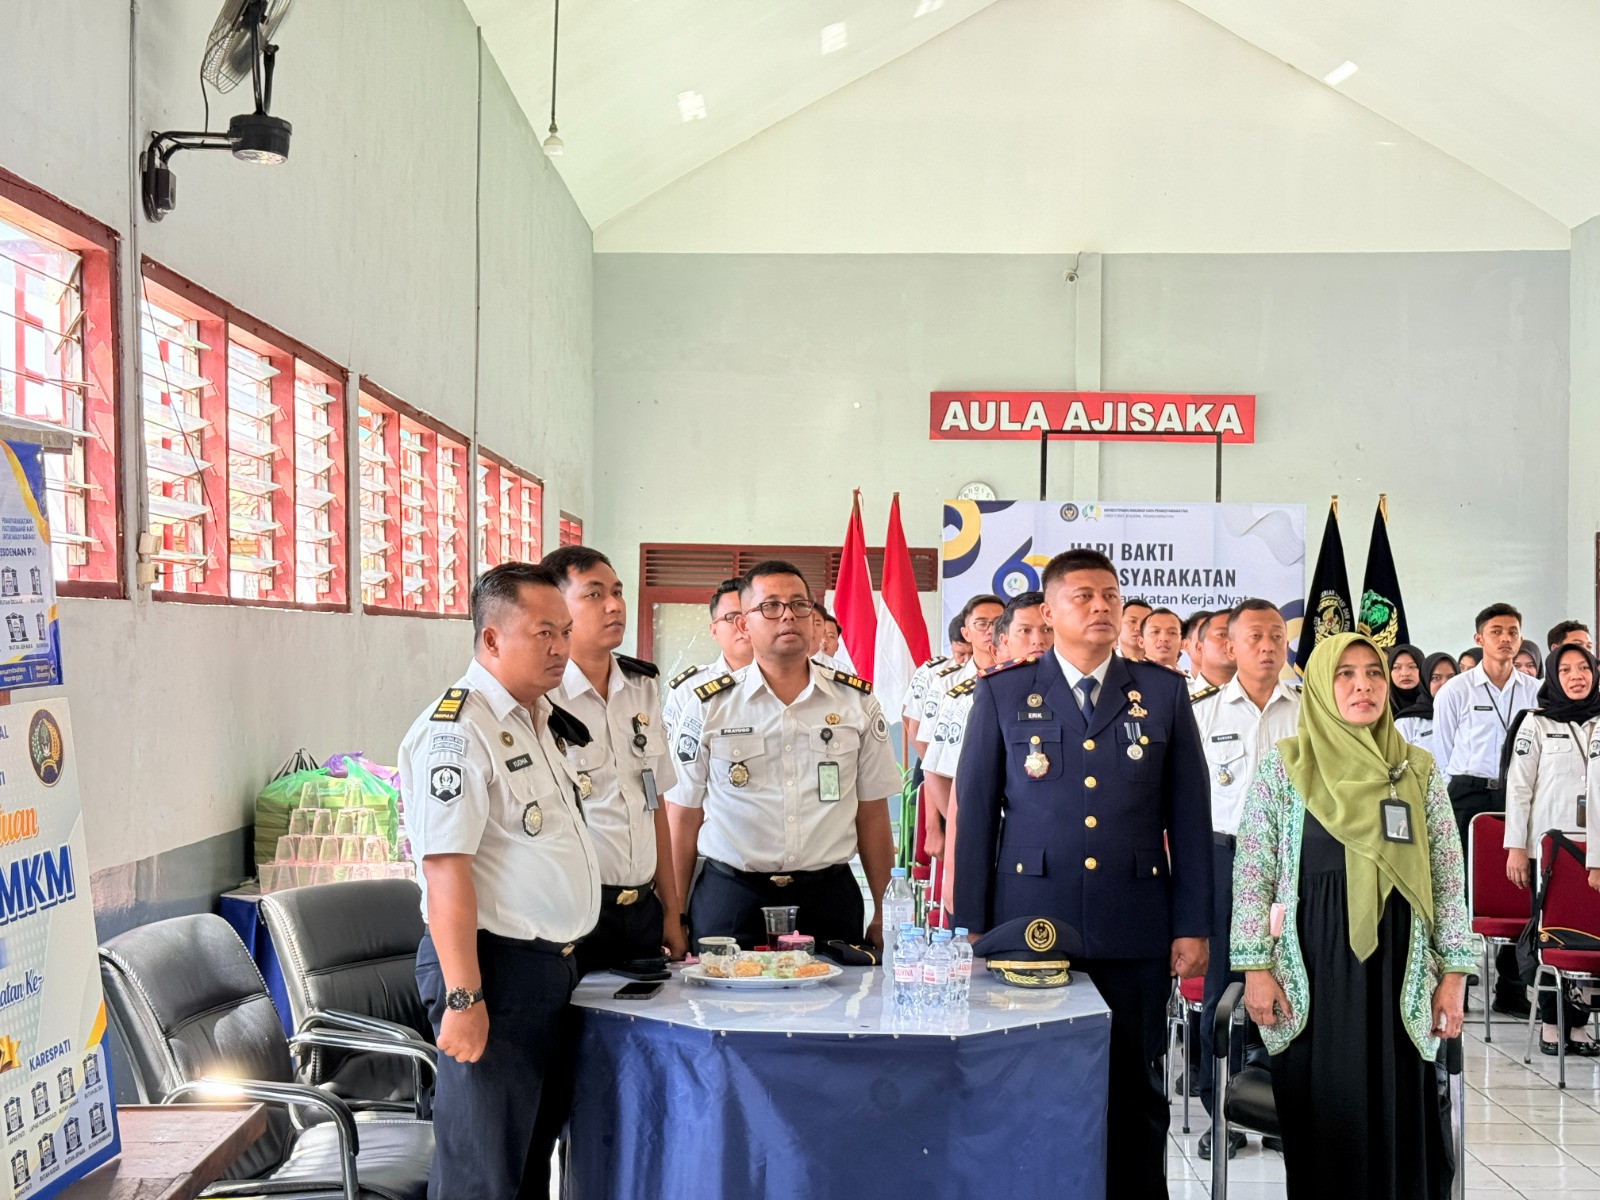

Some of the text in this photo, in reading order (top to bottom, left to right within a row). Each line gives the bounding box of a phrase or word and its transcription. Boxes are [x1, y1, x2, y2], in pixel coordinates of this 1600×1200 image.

[941, 400, 1244, 434] AULA AJISAKA
[1121, 543, 1174, 562] BAKTI
[1120, 568, 1236, 588] SYARAKATAN
[1181, 594, 1214, 608] Kerja
[512, 756, 529, 768] YUDHA
[0, 806, 38, 842] uan
[25, 968, 42, 996] Ke-
[29, 1038, 71, 1072] KARESPATI
